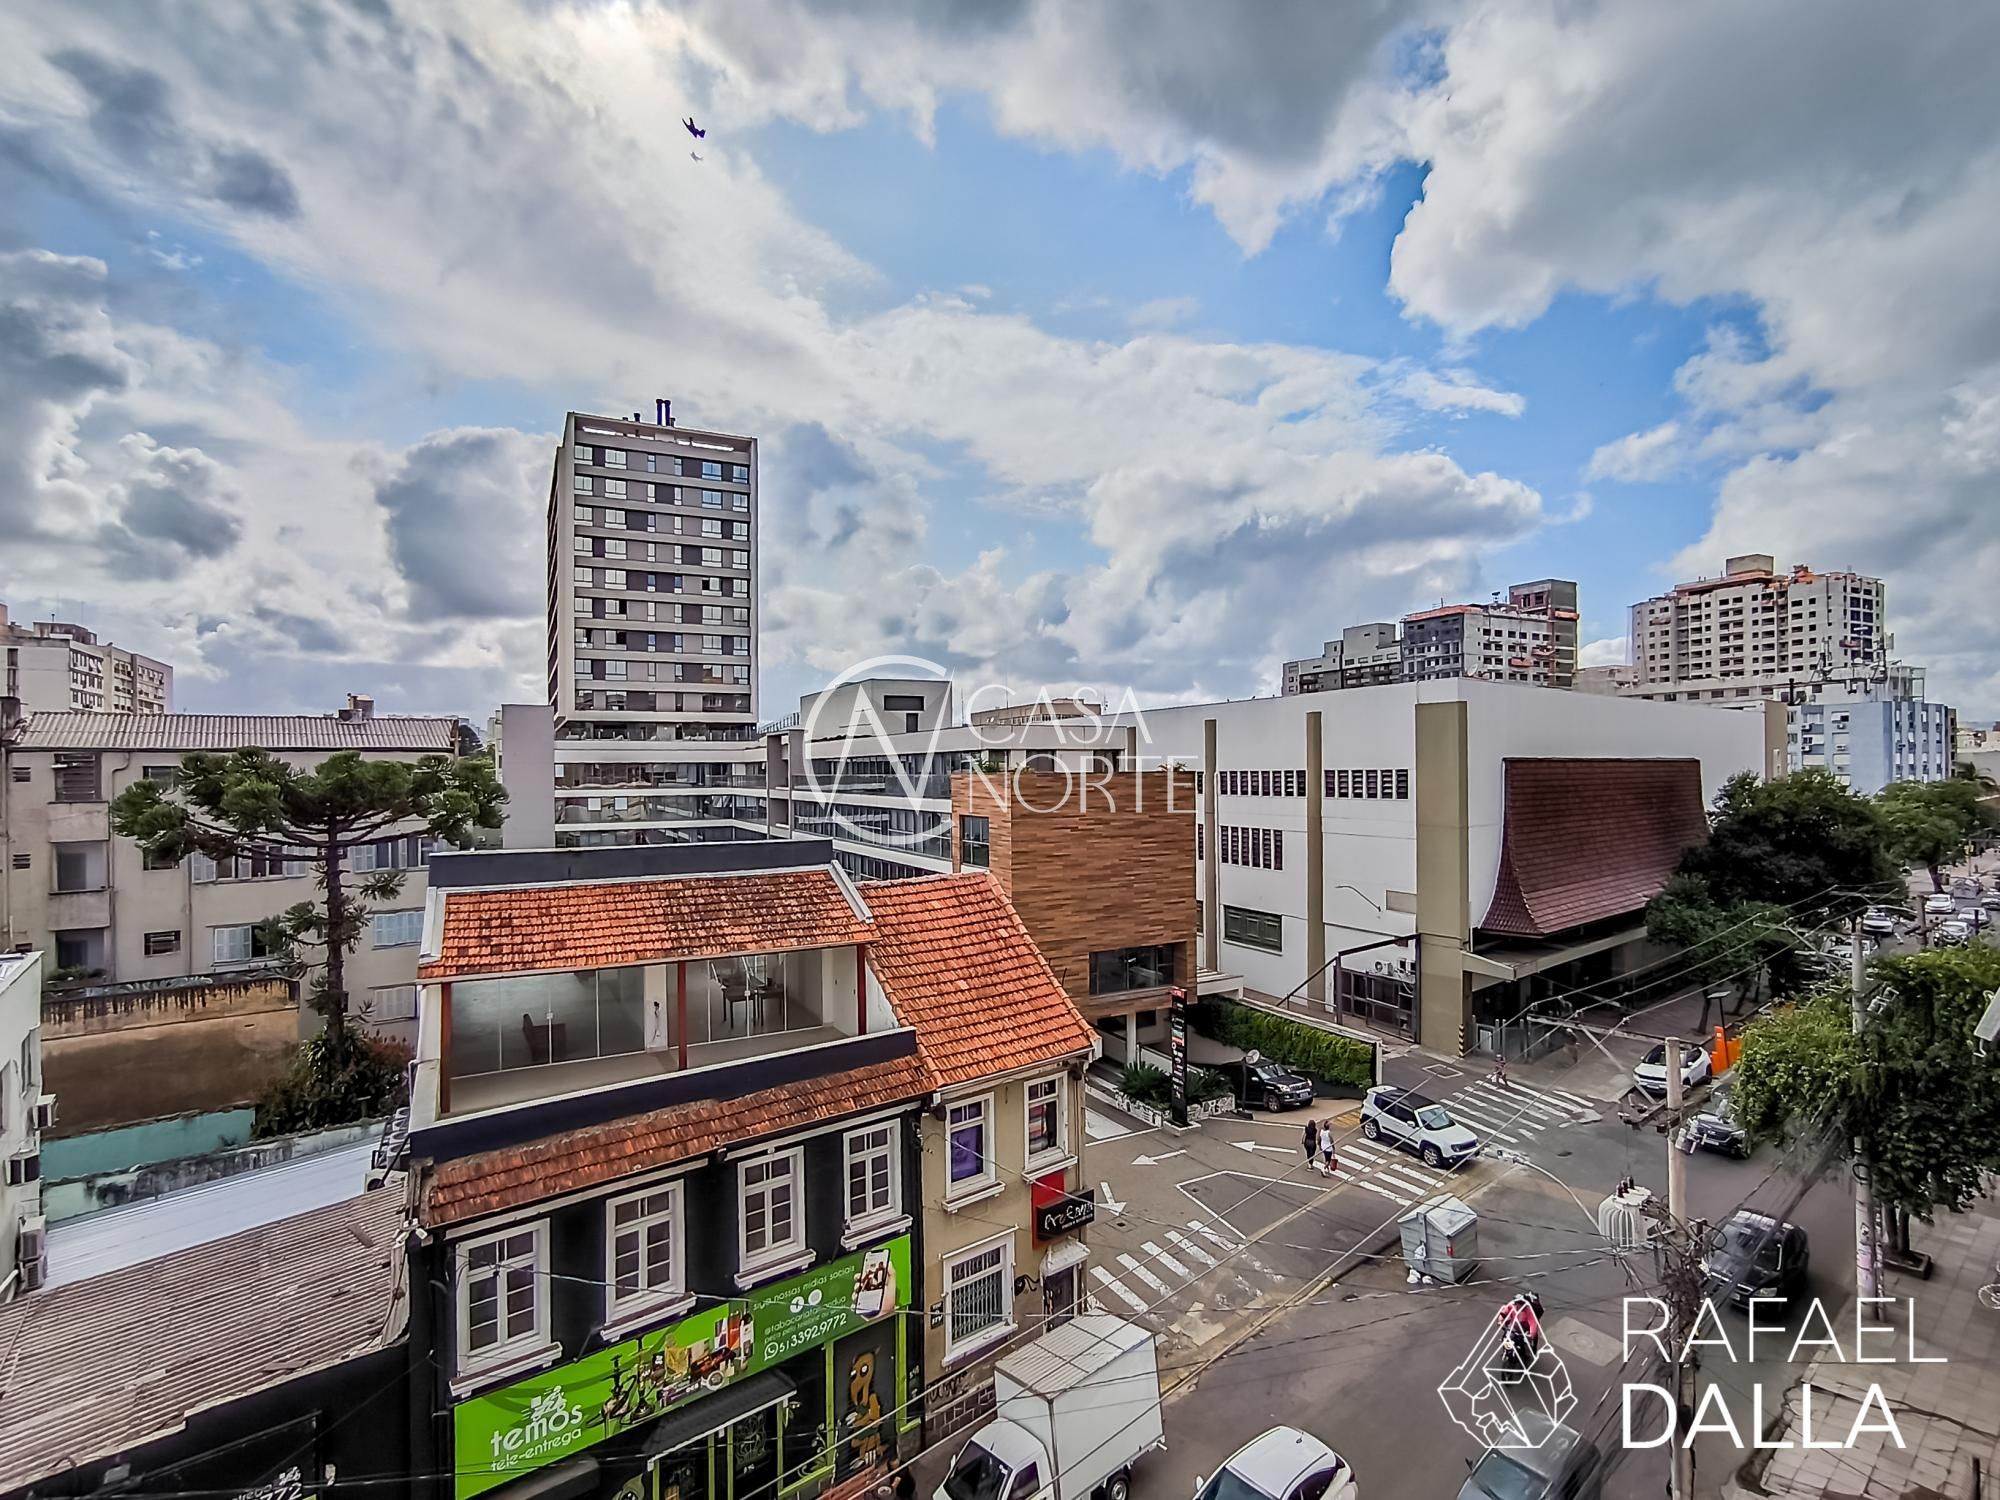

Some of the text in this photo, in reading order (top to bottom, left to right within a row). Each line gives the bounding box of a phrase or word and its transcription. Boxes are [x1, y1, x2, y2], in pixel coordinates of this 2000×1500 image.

[830, 1265, 855, 1281] sociais
[791, 1312, 847, 1347] 3392.9772
[490, 1404, 583, 1457] temos
[490, 1428, 582, 1471] tele-entrega
